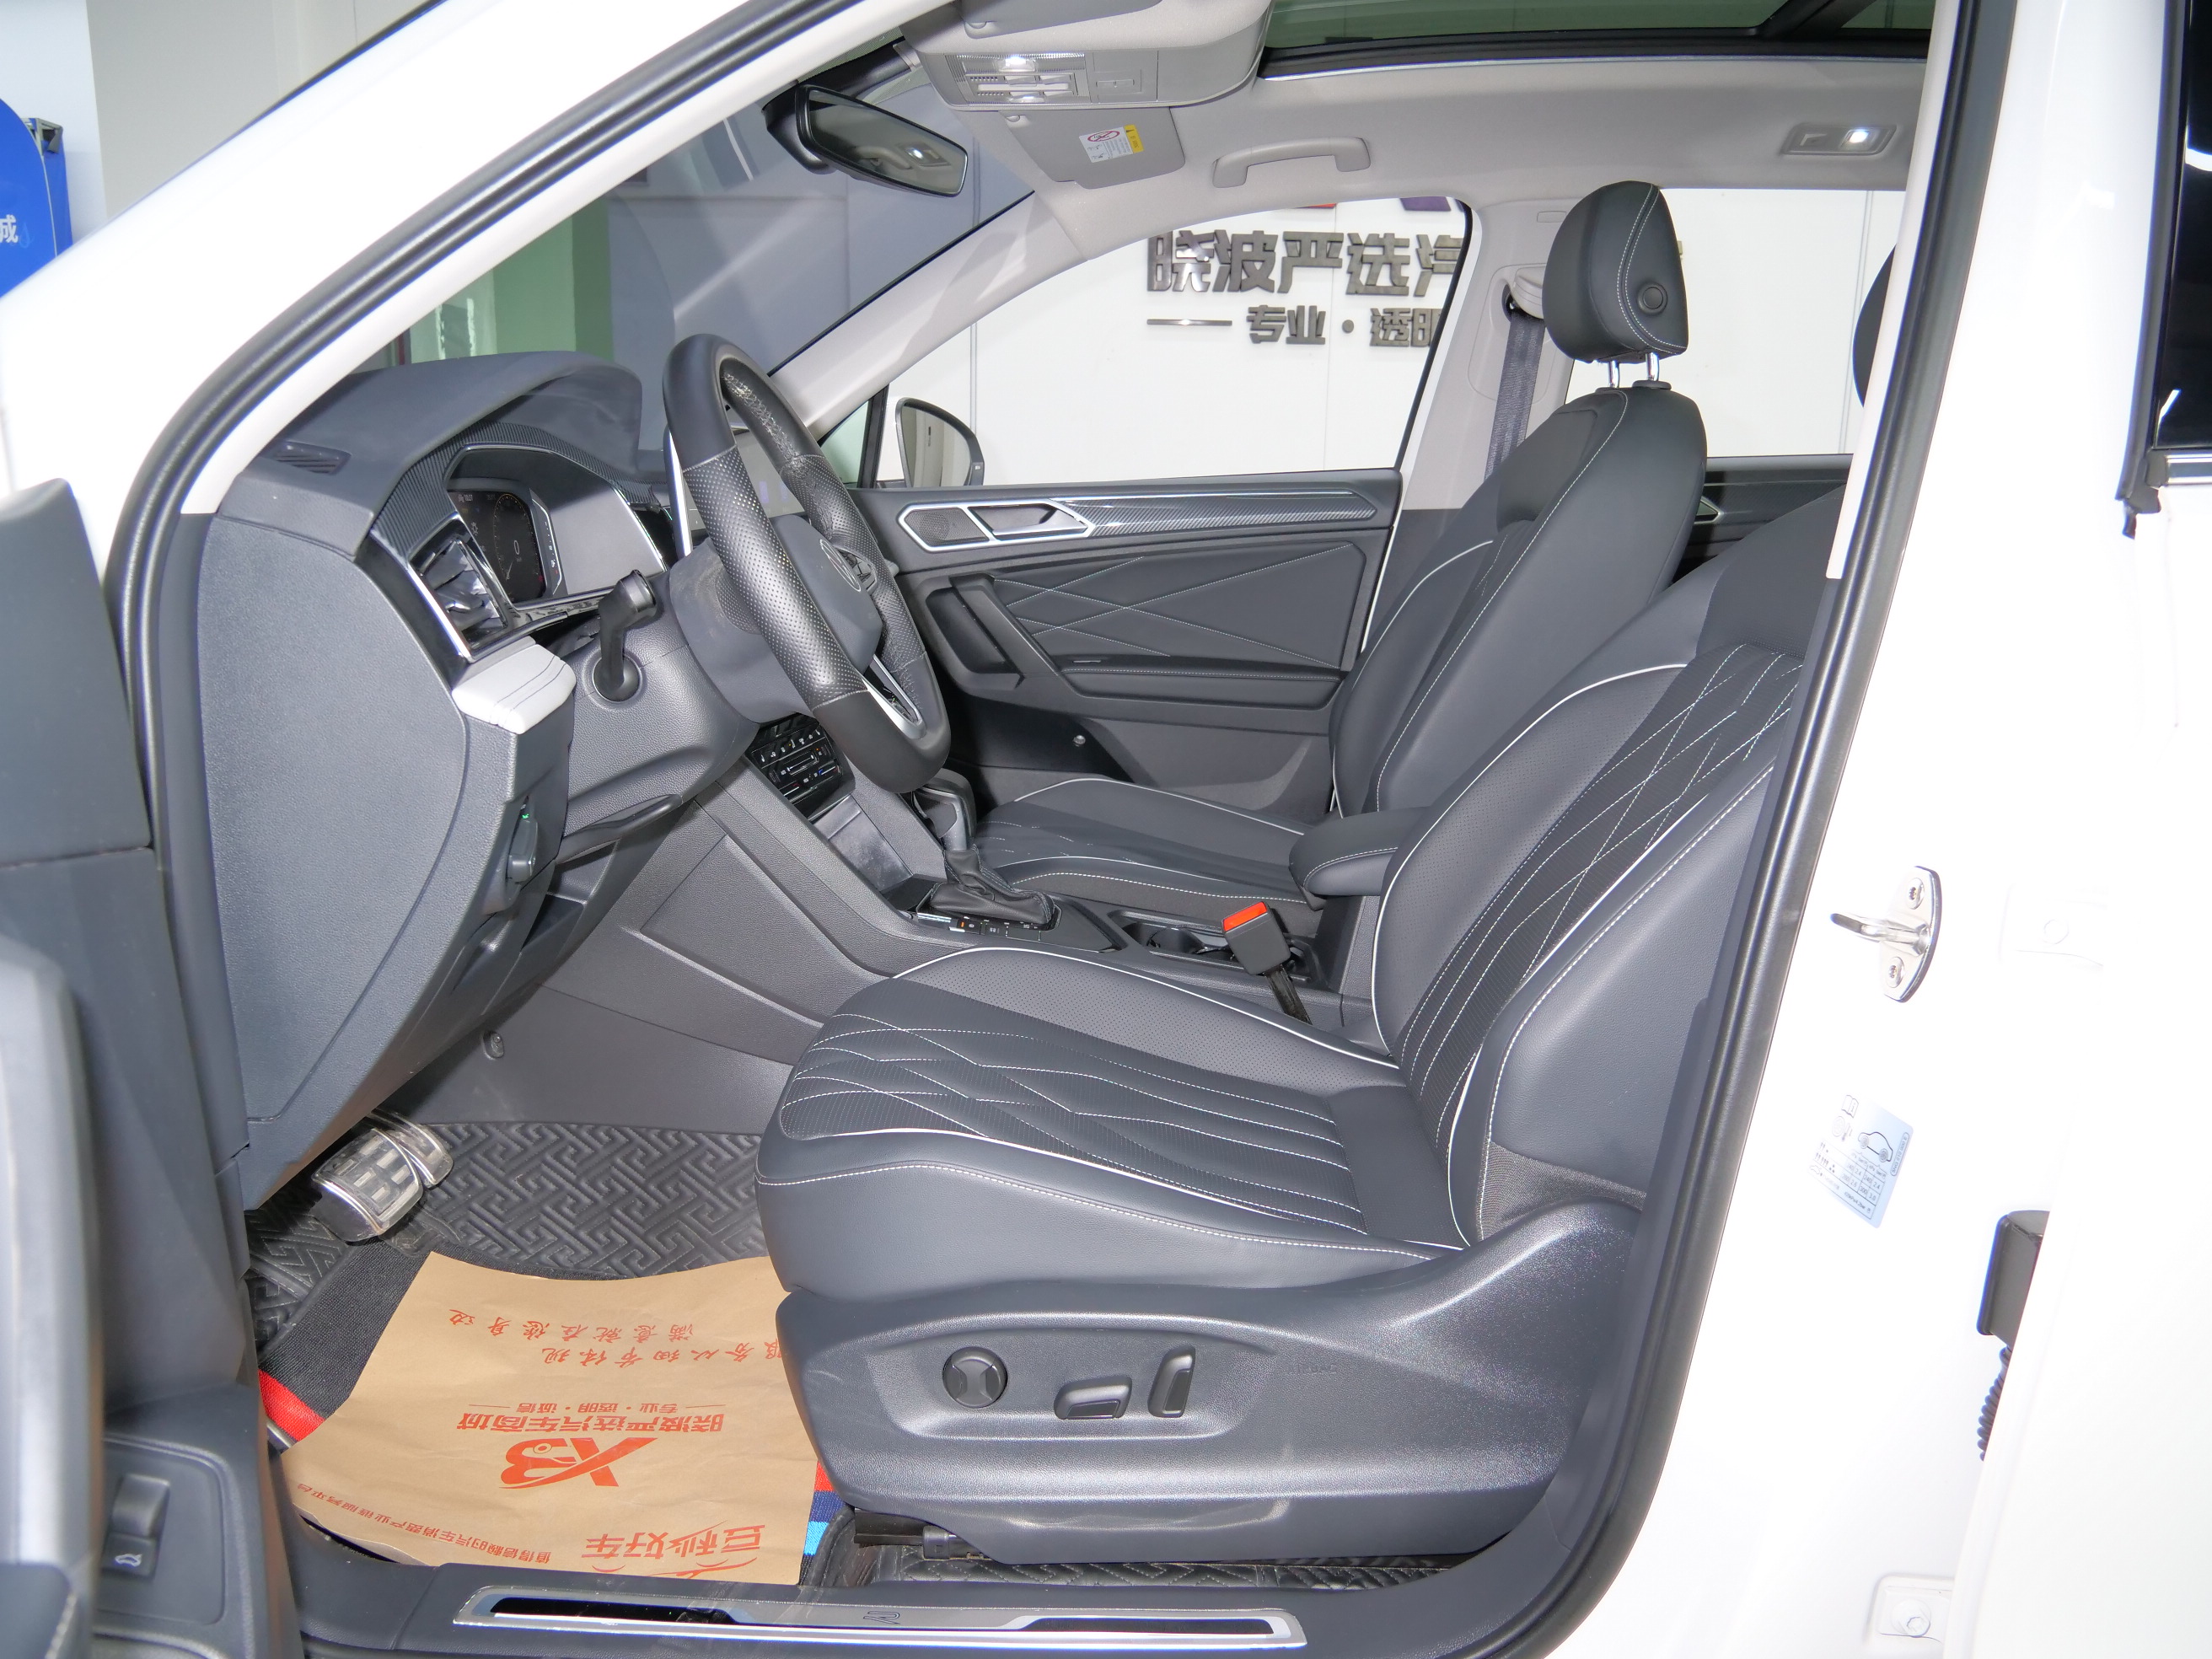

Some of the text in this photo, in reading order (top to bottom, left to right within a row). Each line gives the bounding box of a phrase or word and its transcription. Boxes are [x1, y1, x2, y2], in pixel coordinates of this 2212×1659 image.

[449, 1309, 693, 1343] 满意就在您身边
[457, 1413, 724, 1432] 晓波严选汽车商城
[298, 1483, 551, 1564] 值得信赖的汽车消费产业链服务平台
